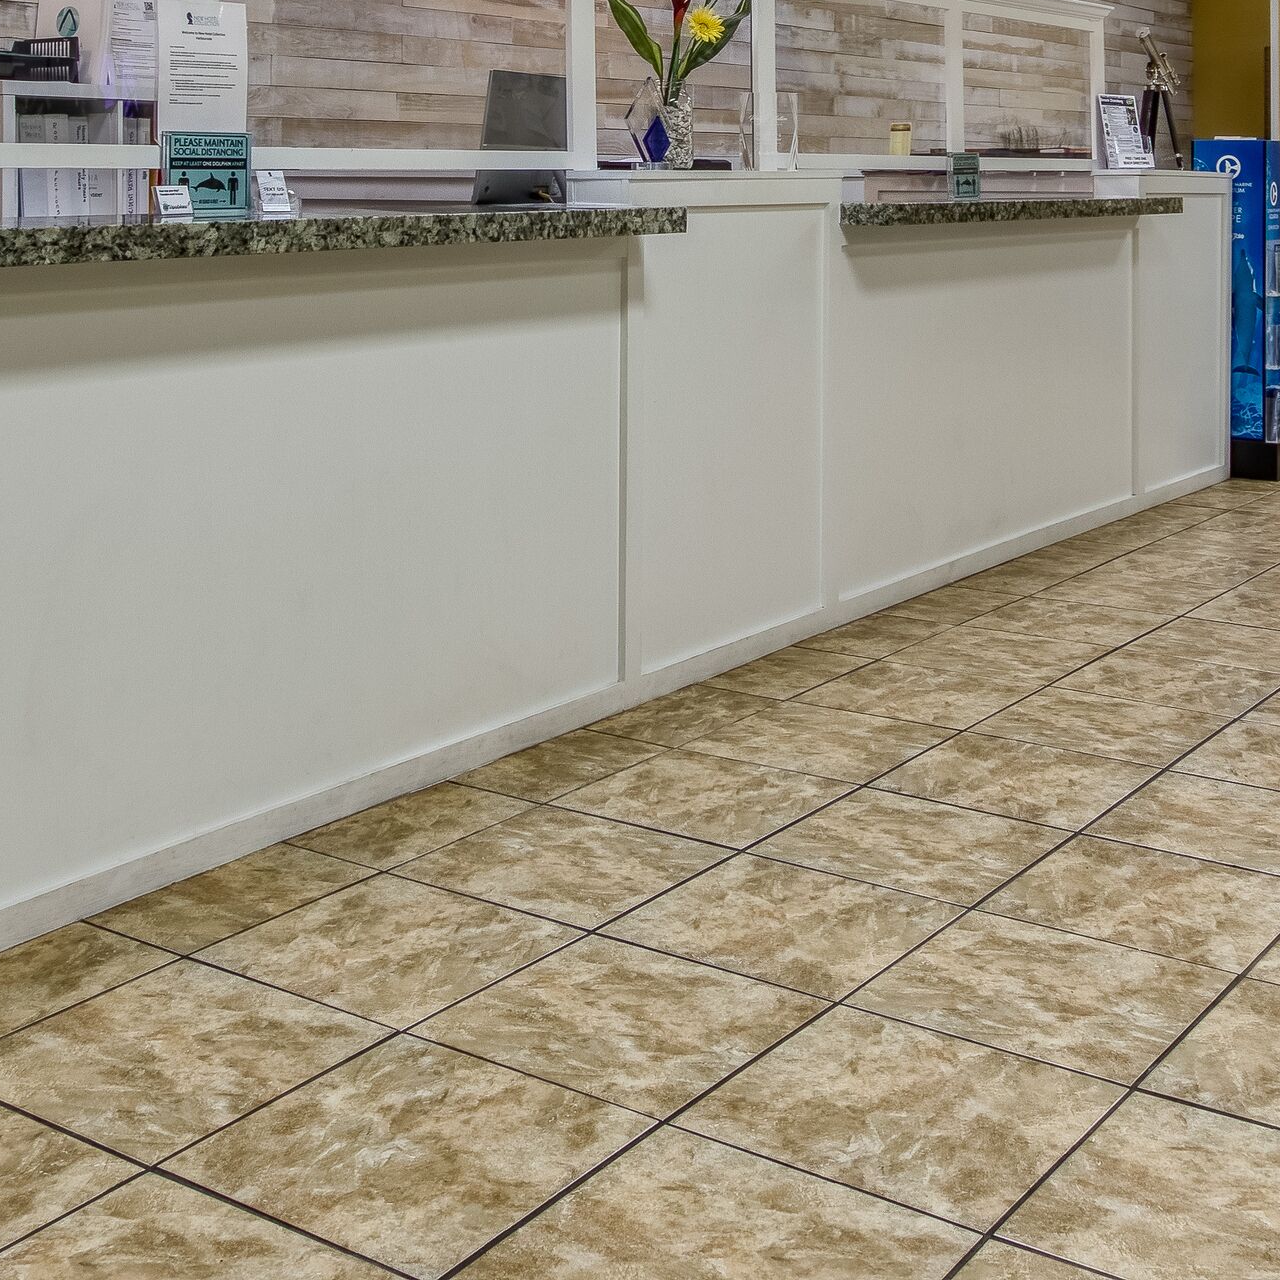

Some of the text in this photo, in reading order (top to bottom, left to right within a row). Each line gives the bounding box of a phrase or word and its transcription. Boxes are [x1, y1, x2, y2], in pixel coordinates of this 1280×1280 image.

[174, 138, 243, 147] PLEASE MAINTAIN
[173, 147, 243, 156] SOCIAL DISTANCING
